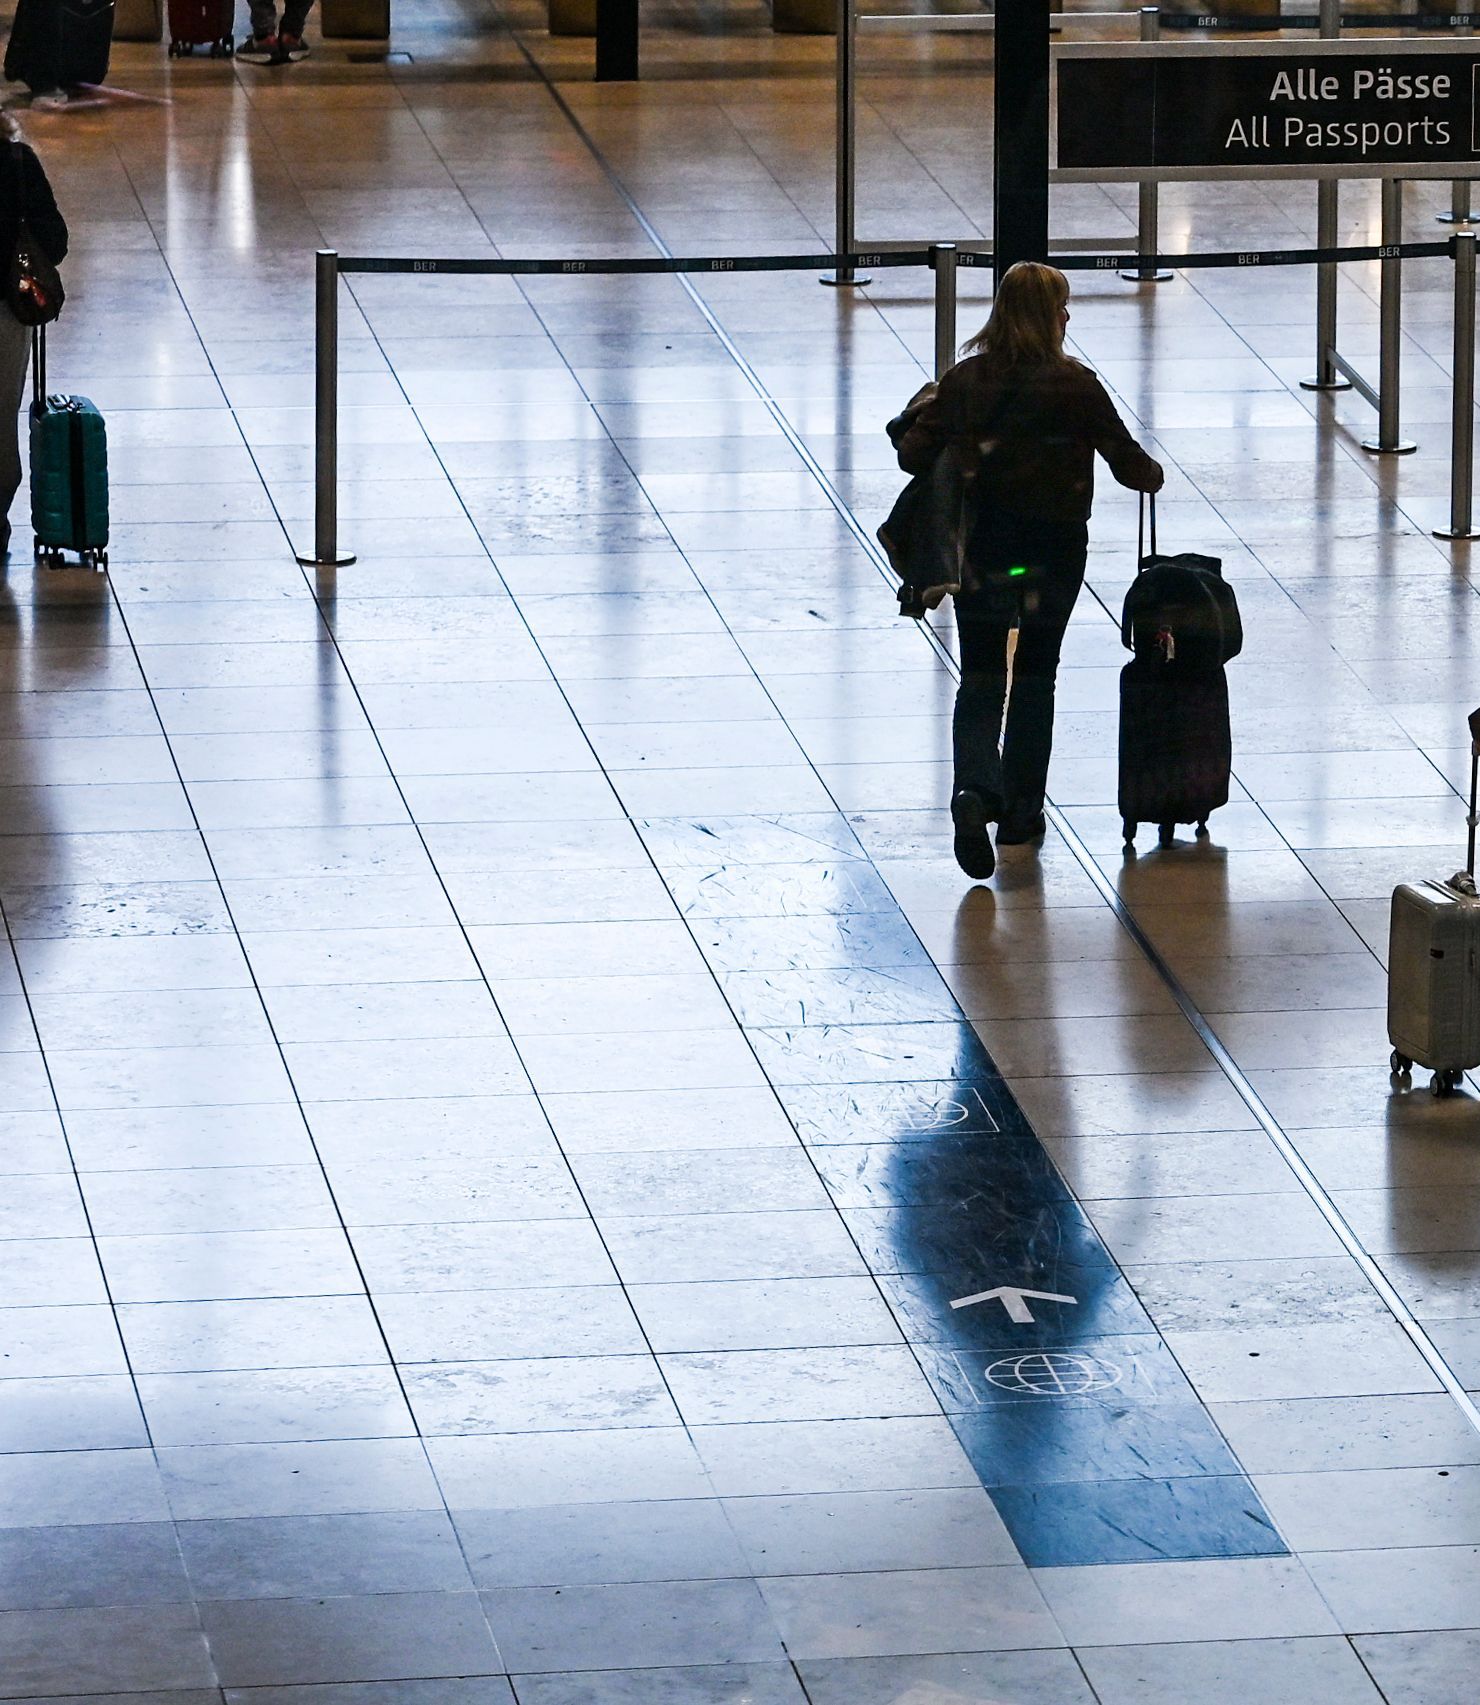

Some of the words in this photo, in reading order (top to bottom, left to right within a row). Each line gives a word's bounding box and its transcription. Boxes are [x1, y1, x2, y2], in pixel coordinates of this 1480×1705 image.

[1198, 16, 1218, 27] BER
[1449, 15, 1470, 26] BER
[1269, 68, 1340, 101] Alle
[1353, 67, 1451, 100] Pässe
[1224, 115, 1270, 149] All
[1284, 115, 1451, 155] Passports
[413, 262, 437, 272] BER
[562, 262, 586, 272] BER
[711, 260, 735, 270] BER
[858, 256, 882, 266] BER
[1096, 257, 1118, 268] BER
[1238, 254, 1260, 265] BER
[1378, 246, 1400, 258] BER
